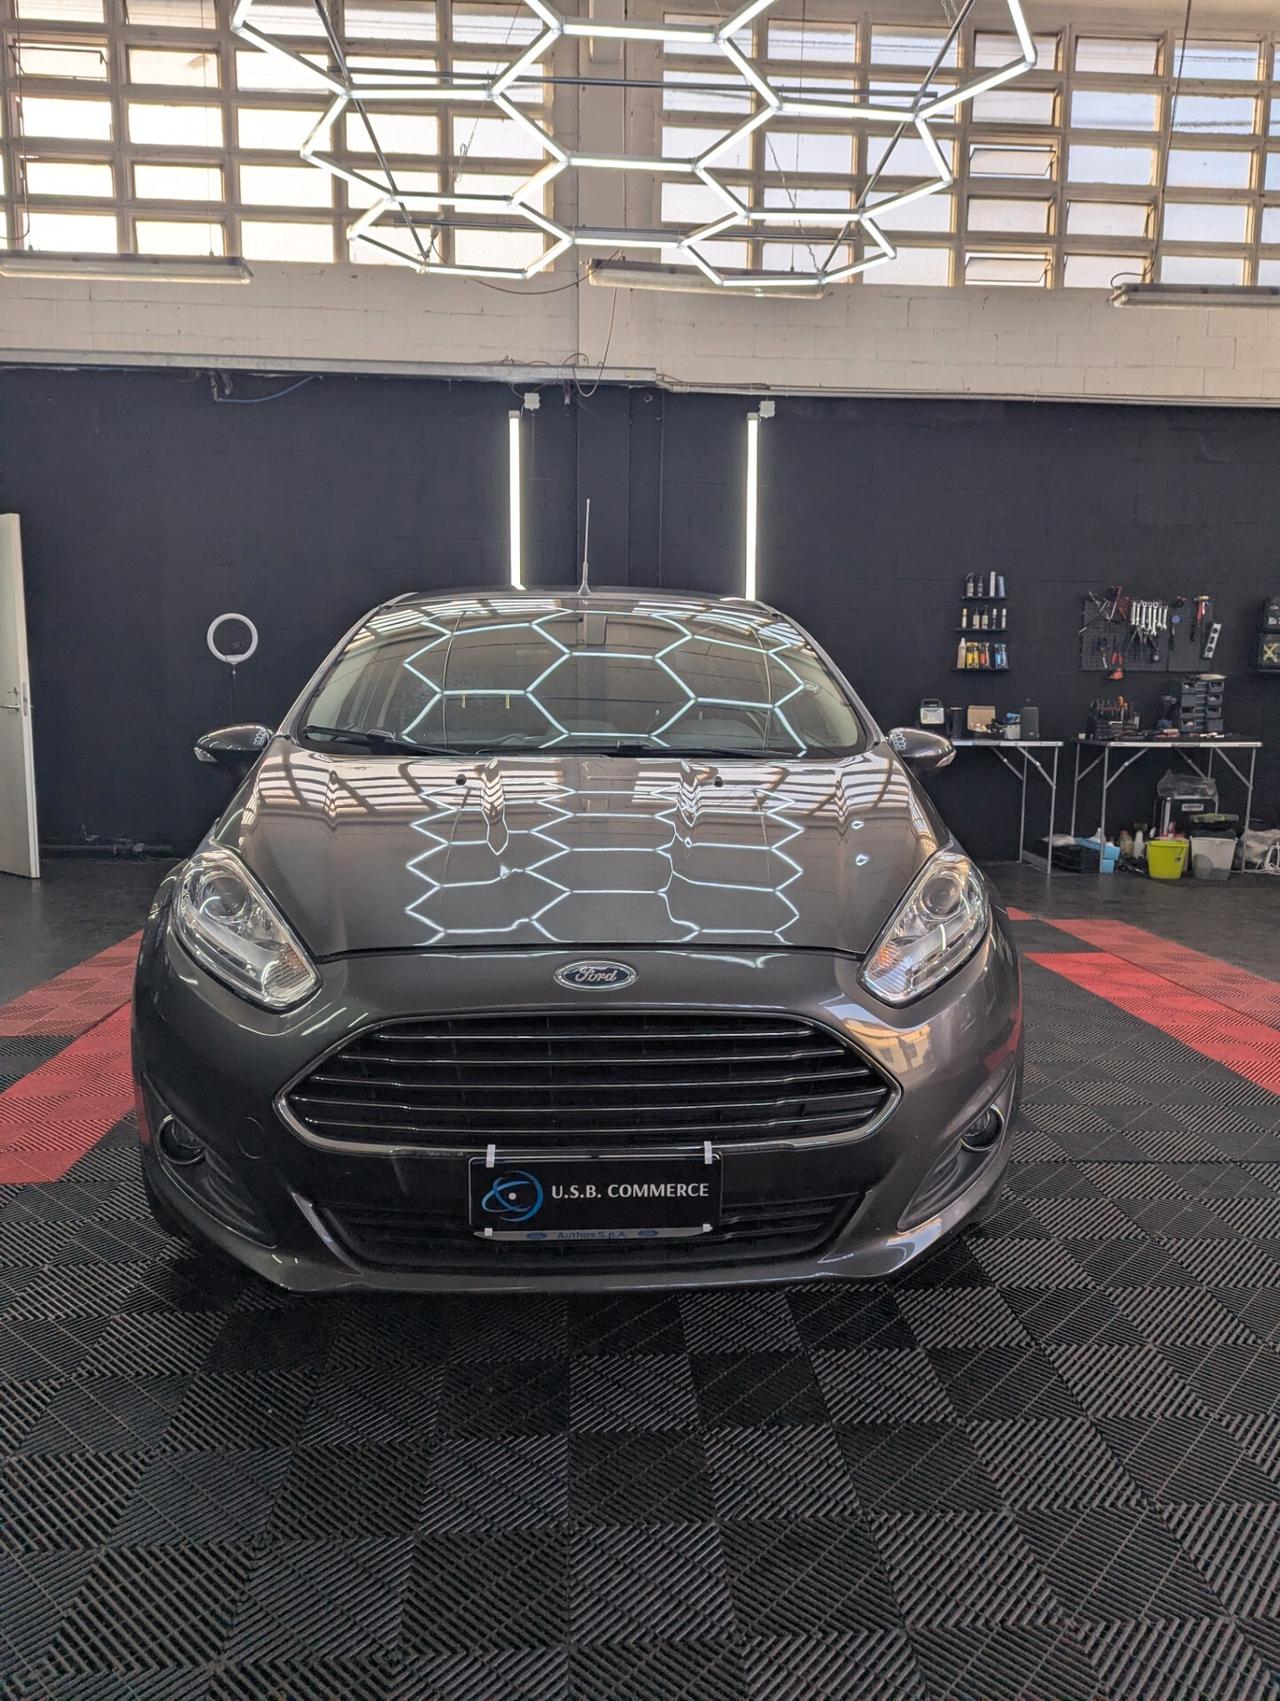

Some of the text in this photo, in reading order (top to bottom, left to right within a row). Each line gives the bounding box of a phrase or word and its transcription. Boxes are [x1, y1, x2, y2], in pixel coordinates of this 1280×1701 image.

[575, 966, 617, 982] Ford
[552, 1183, 709, 1199] U.S.B. COMMERCE
